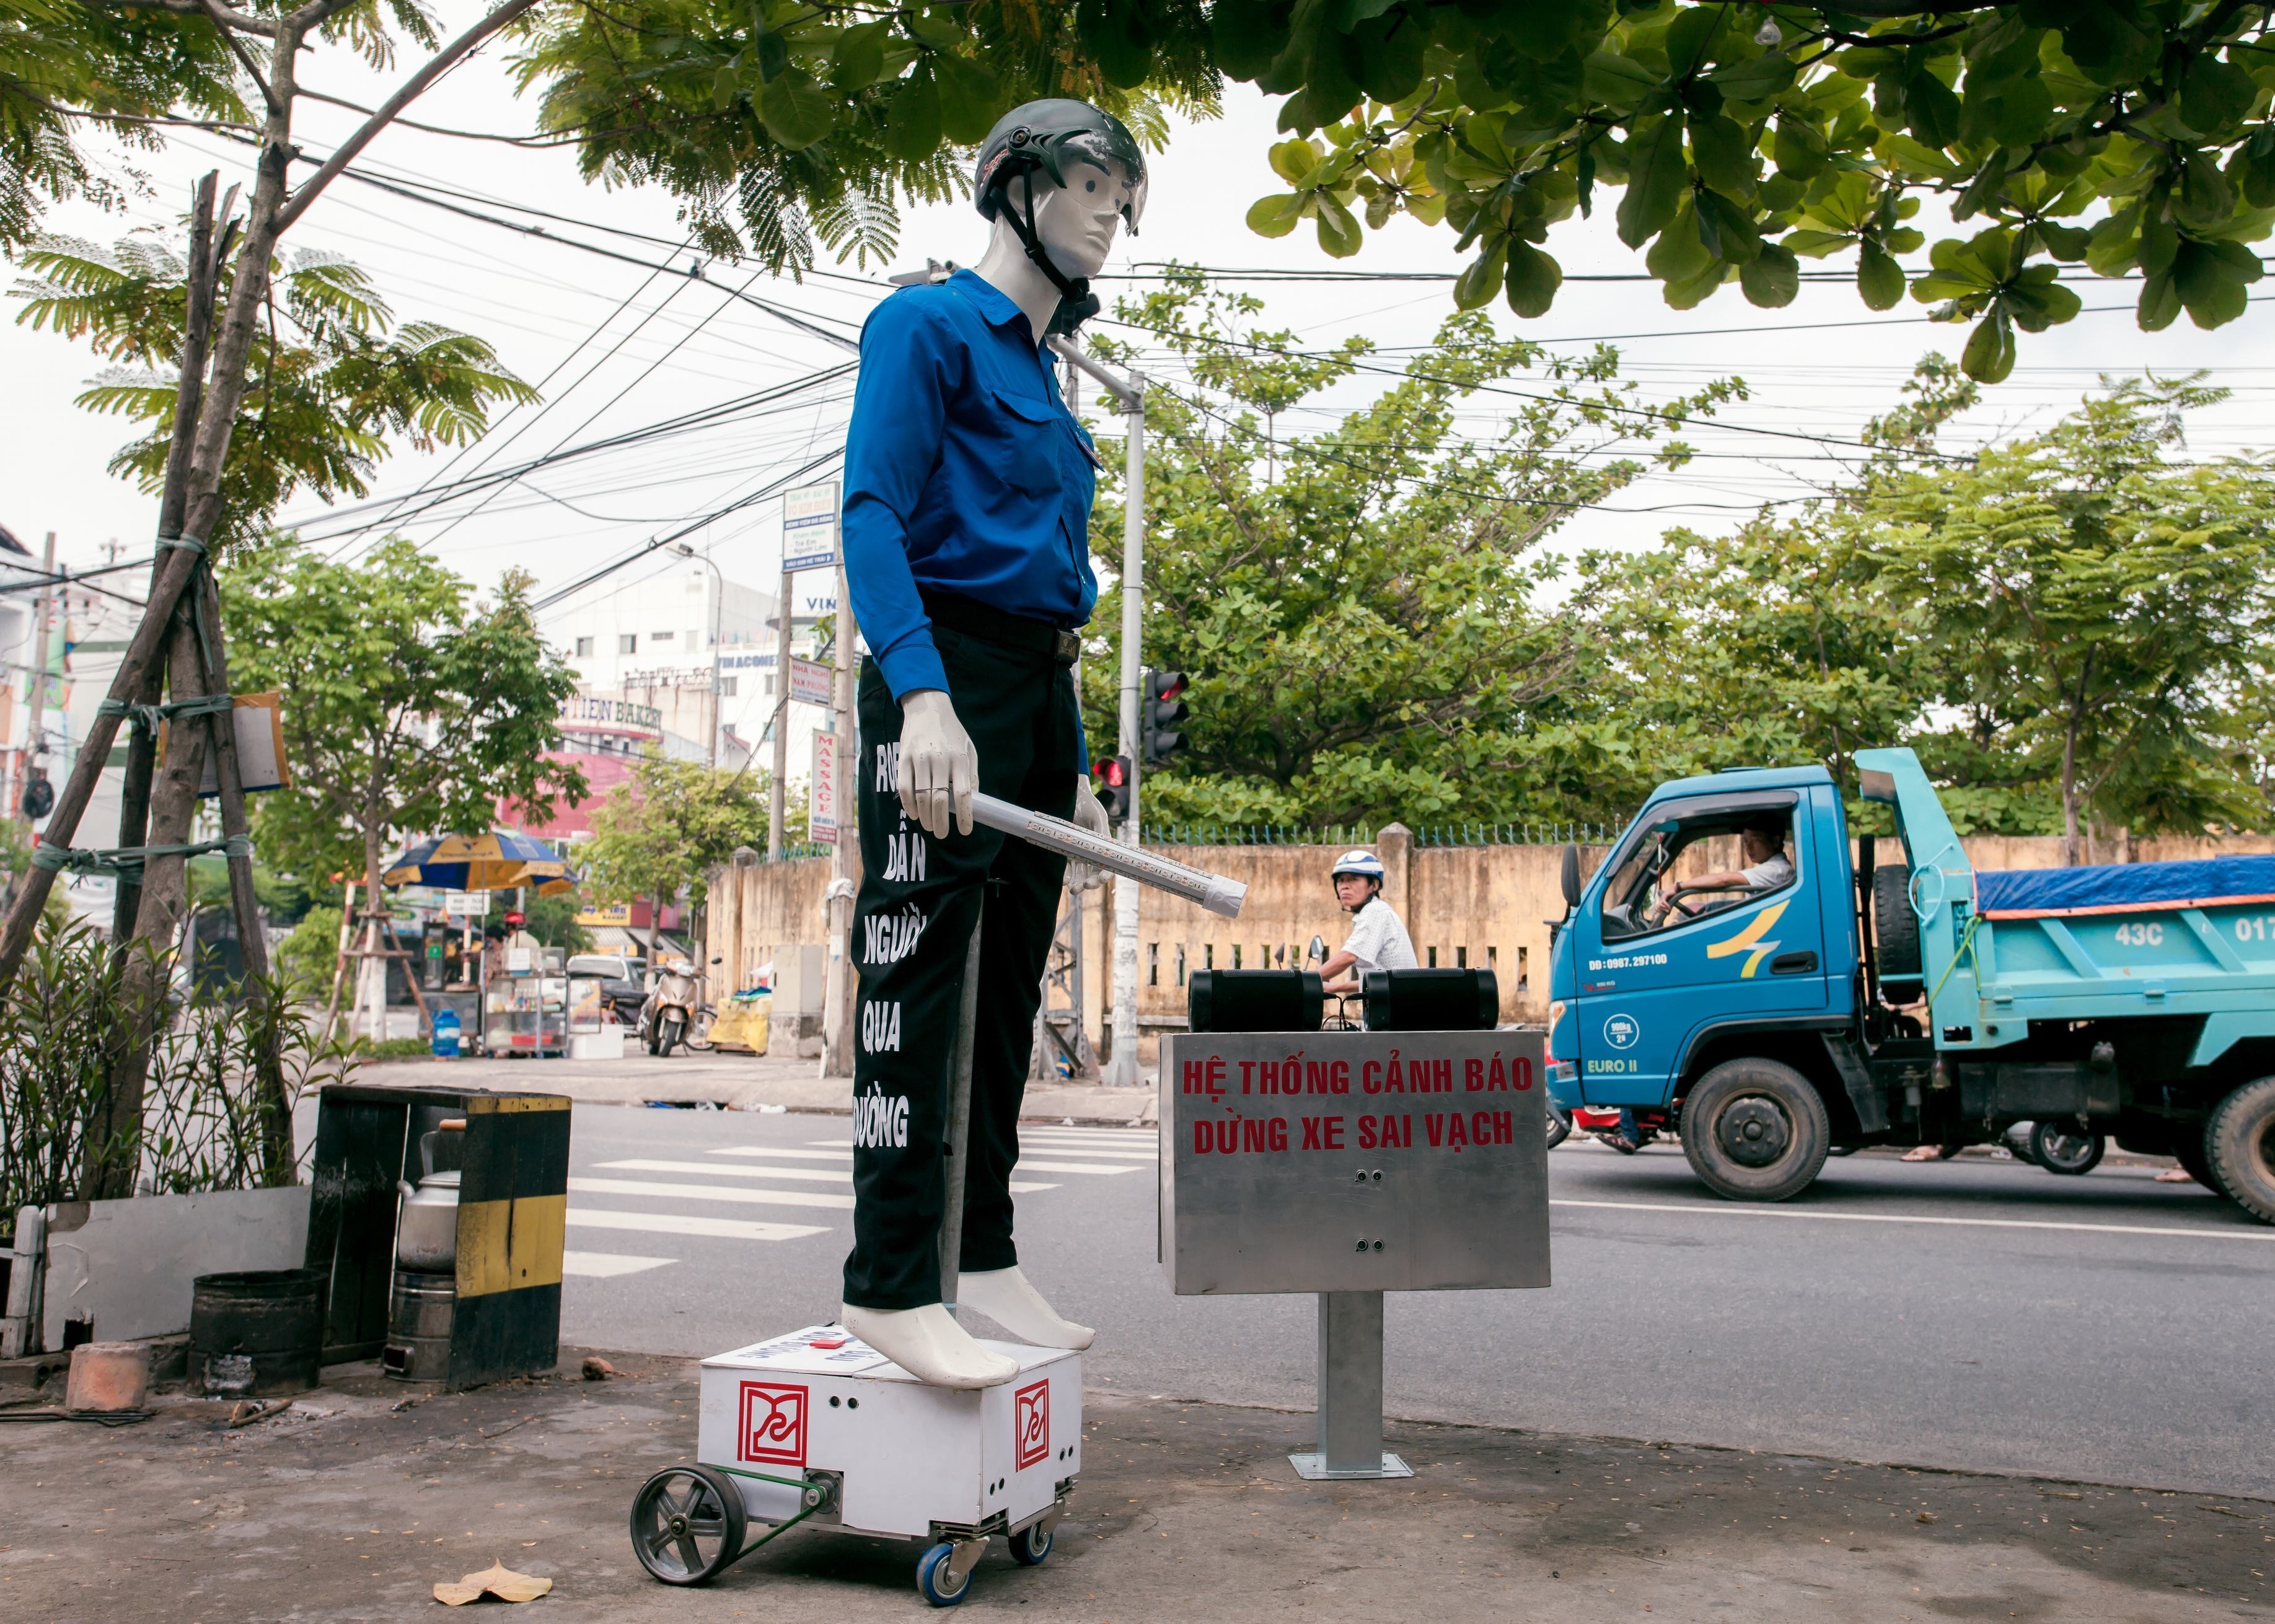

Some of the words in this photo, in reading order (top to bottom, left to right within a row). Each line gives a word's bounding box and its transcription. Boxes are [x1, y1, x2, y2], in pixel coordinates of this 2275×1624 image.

[817, 735, 834, 814] MASSAGE
[2115, 923, 2163, 946] 43C
[863, 1000, 900, 1056] QUA
[1183, 1055, 1226, 1103] HỆ
[1238, 1050, 1349, 1095] THỐNG
[1362, 1049, 1453, 1094] CẢNH
[1464, 1051, 1533, 1092] BÁO
[1587, 1059, 1625, 1073] EURO
[1629, 1059, 1637, 1073] II
[1194, 1107, 1288, 1154] DỪNG
[1301, 1116, 1345, 1151] XE
[1358, 1114, 1412, 1149] SAI
[1424, 1110, 1513, 1153] VẠCH
